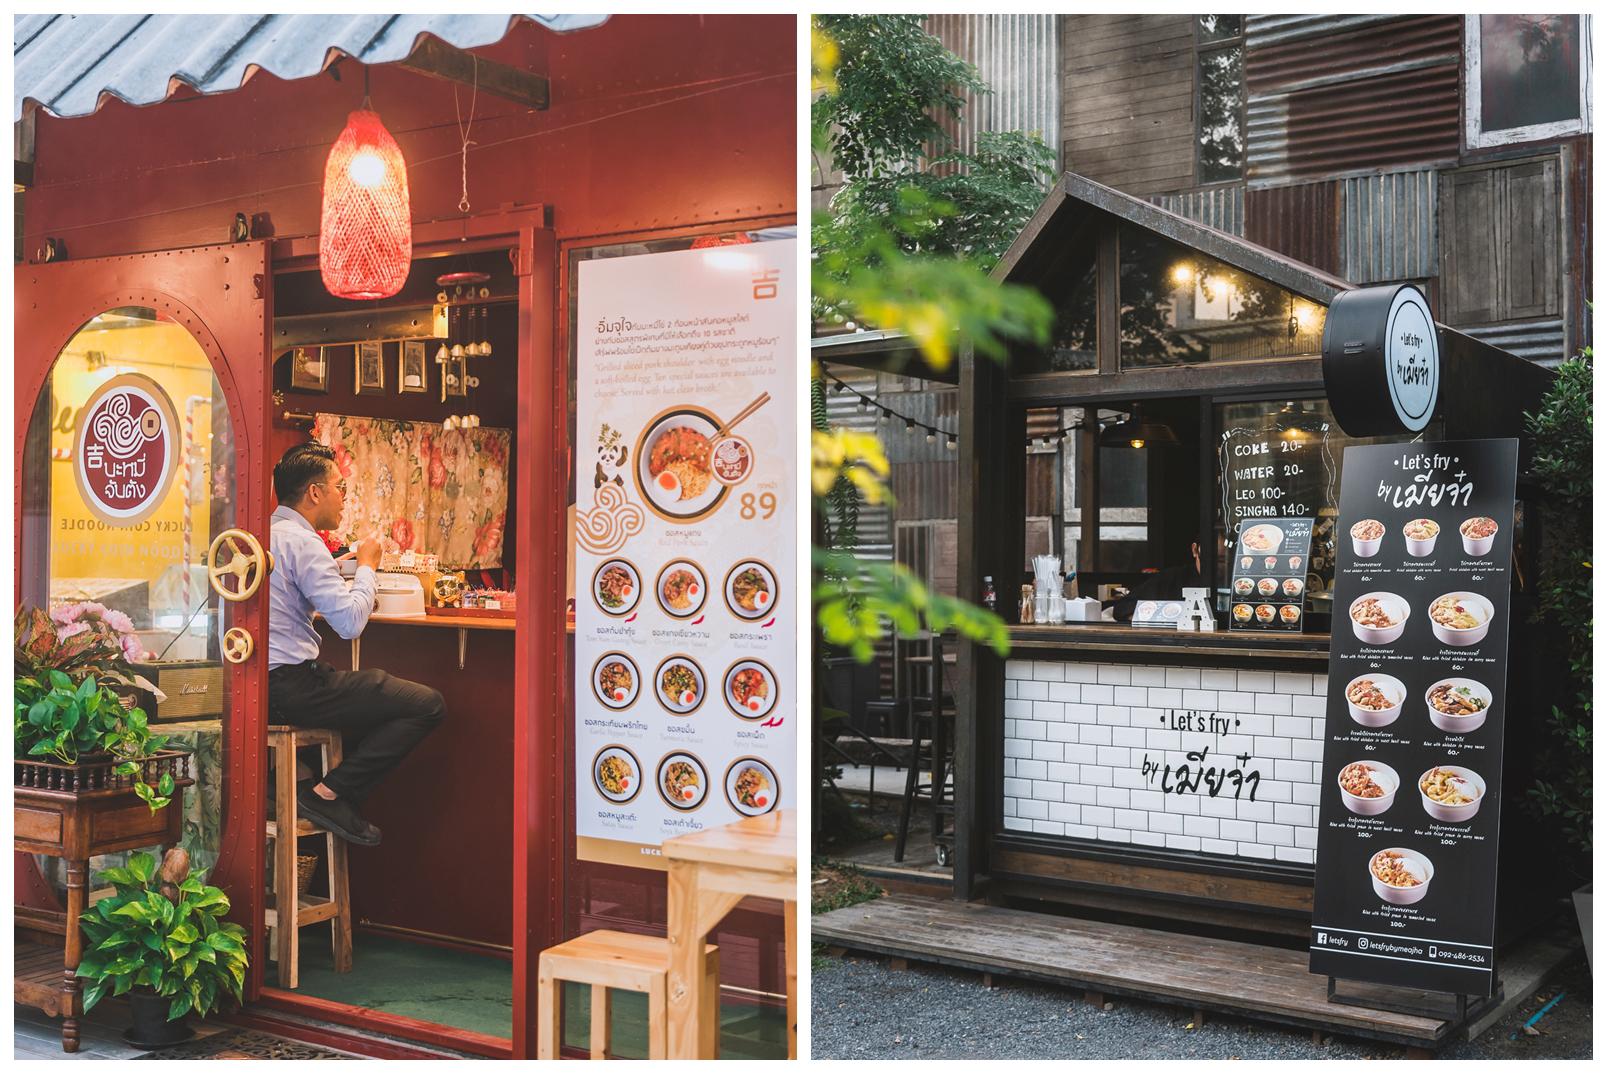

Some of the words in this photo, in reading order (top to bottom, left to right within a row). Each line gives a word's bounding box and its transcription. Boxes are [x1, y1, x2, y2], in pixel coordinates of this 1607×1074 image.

[667, 320, 672, 329] 2
[87, 443, 104, 469] 吉
[1235, 442, 1269, 456] COKE
[1403, 454, 1431, 470] Let's
[1433, 454, 1450, 471] fry
[1234, 466, 1274, 480] WATER
[1235, 489, 1255, 500] LEO
[1377, 480, 1392, 502] by
[1393, 469, 1473, 508] เมียจ๋า
[740, 492, 777, 519] 89
[1235, 505, 1277, 516] SINGHA
[1177, 587, 1217, 632] A
[1171, 709, 1206, 732] Let's
[1209, 713, 1230, 736] fry
[1142, 753, 1159, 784] by
[1162, 746, 1260, 802] เมียจ๋า
[1329, 935, 1349, 947] letsfry
[1438, 951, 1485, 963] 092-486-2534
